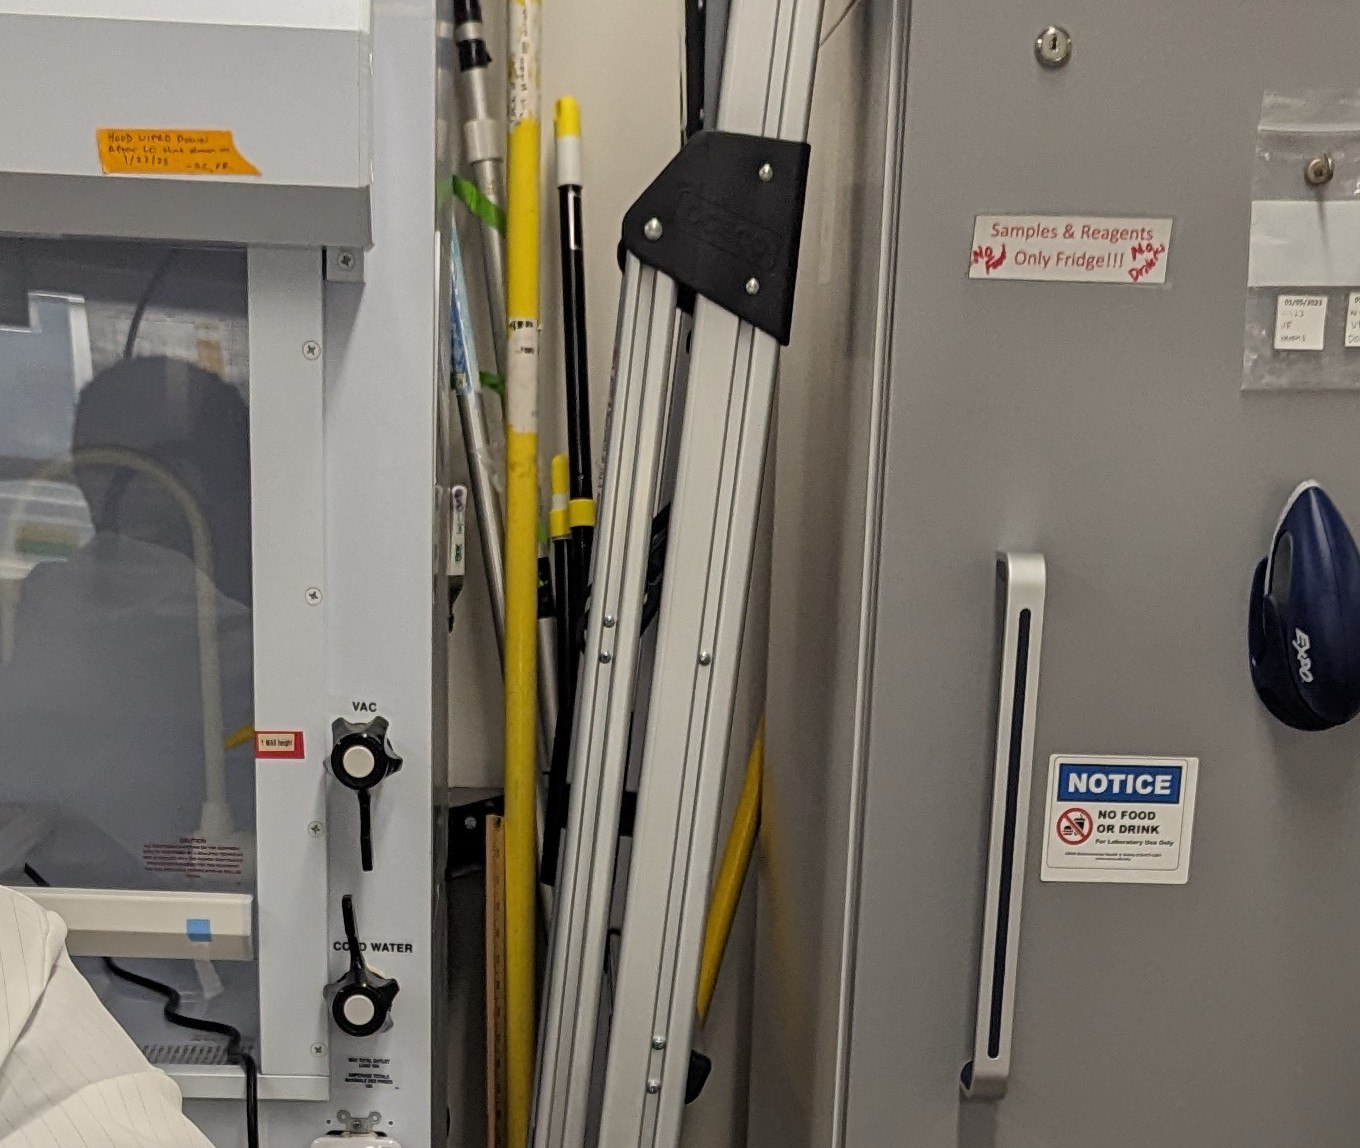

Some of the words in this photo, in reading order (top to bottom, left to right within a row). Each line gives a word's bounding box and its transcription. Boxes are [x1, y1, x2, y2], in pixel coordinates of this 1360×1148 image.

[990, 222, 1058, 241] Samples
[1062, 224, 1075, 239] &
[1080, 224, 1154, 244] Reagents
[1014, 250, 1051, 269] Only
[1292, 627, 1314, 683] EXPO
[352, 701, 378, 713] VAC
[1068, 772, 1173, 795] NOTICE
[1097, 810, 1117, 820] NO
[1120, 810, 1156, 821] FOOD
[1096, 824, 1115, 834] OR
[1118, 825, 1160, 835] DRINK
[333, 941, 367, 953] COD
[371, 942, 414, 954] WATER
